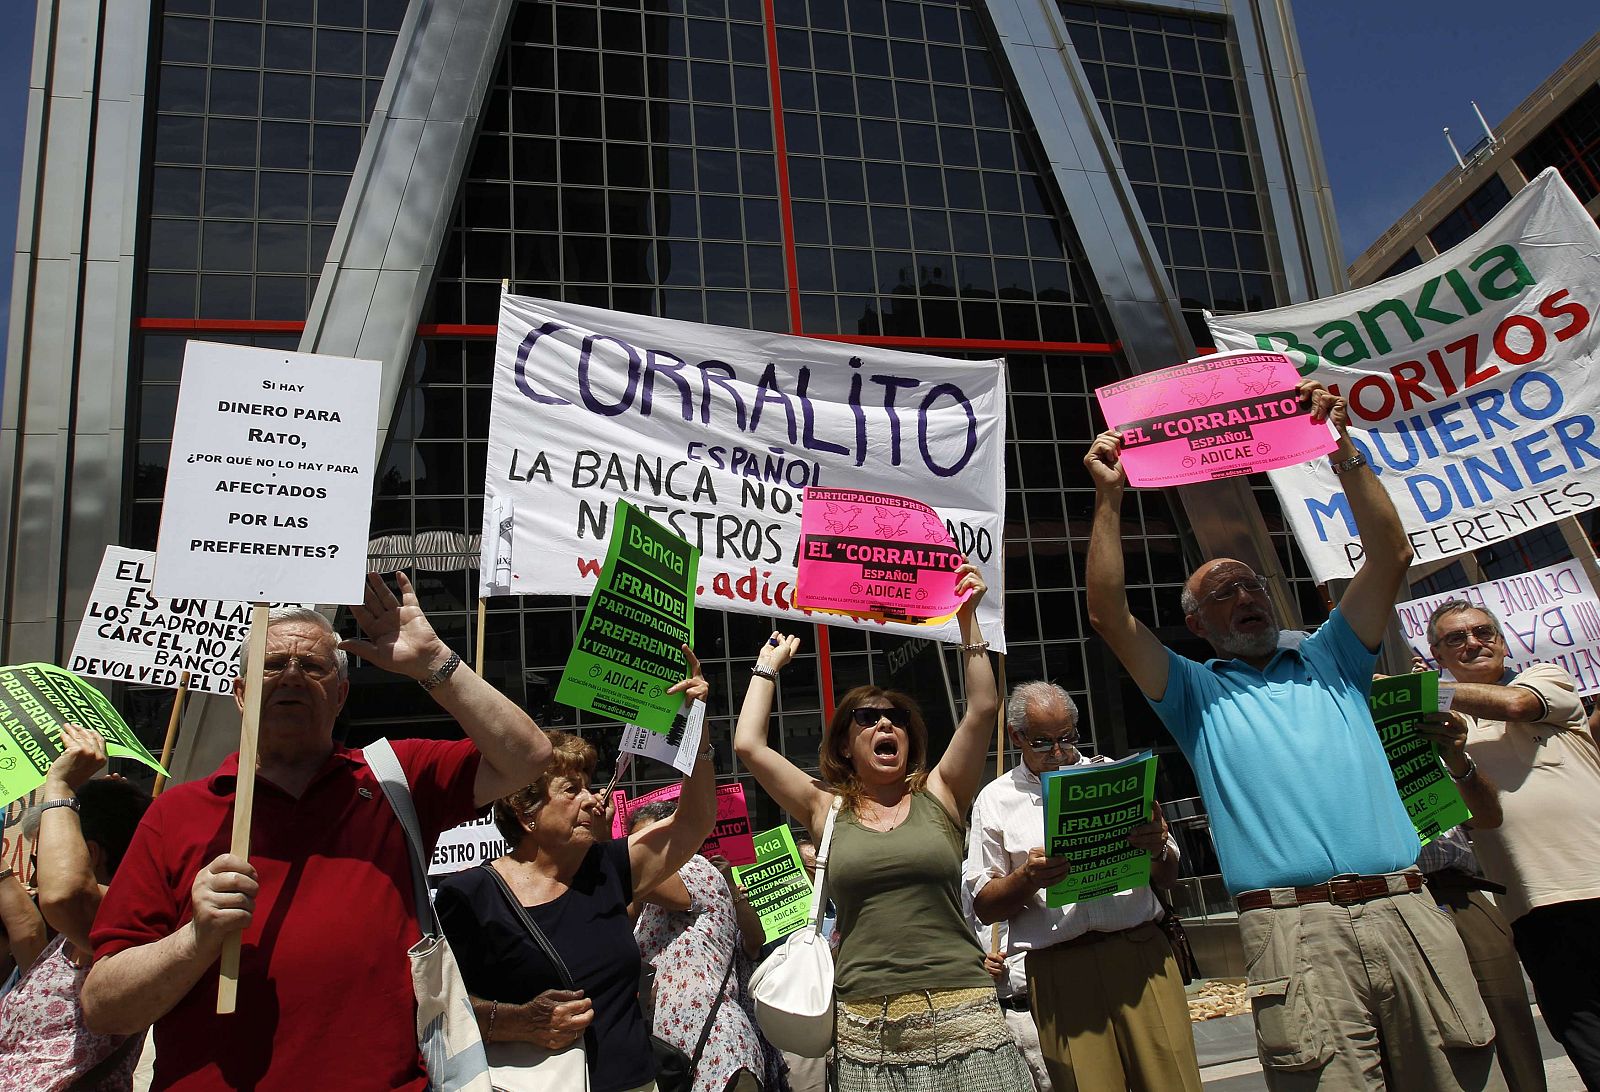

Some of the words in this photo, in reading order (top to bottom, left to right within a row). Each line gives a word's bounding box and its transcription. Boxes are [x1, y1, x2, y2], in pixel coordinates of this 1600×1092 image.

[1255, 244, 1537, 377] Bankia
[1328, 288, 1591, 428] ORIZOS
[279, 382, 305, 393] HAY
[1102, 364, 1206, 398] PARTICIPACIONES
[1206, 355, 1286, 371] PREFERENTES
[218, 400, 288, 418] DINERO
[293, 407, 342, 423] PARA
[248, 428, 307, 449] RATO,
[1122, 427, 1151, 446] EL
[1190, 430, 1251, 450] ESPAÑOL
[187, 453, 222, 464] ¿POR
[226, 455, 253, 467] QUÉ
[256, 458, 275, 468] NO
[278, 460, 294, 470] LO
[298, 462, 323, 472] HAY
[327, 464, 359, 475] PARA
[1200, 446, 1254, 466] ADICAE
[215, 480, 327, 499] AFECTADOS
[509, 448, 552, 482] LA
[572, 450, 717, 504] BANCA
[1304, 492, 1358, 543] M
[1404, 413, 1600, 525] DINER
[808, 491, 901, 507] PARTICIPACIONES
[228, 512, 267, 526] POR
[273, 515, 309, 529] LAS
[577, 499, 782, 564] NSTROS
[1344, 482, 1595, 572] PFERENTES
[190, 539, 340, 559] PREFERENTES?
[629, 524, 684, 577] Bankia
[808, 541, 833, 559] EL
[115, 560, 151, 584] EL
[863, 569, 916, 582] ESPAÑOL
[126, 587, 159, 611] ES
[169, 598, 207, 618] UN
[613, 571, 685, 620] ¡FRAUDE!
[865, 584, 912, 600] ADICAE
[89, 602, 132, 624] LOS
[140, 611, 249, 642] LADRONES
[597, 595, 689, 644] PARTICIPACIONES
[98, 623, 192, 654] CARCEL,
[196, 638, 226, 658] NO
[590, 616, 688, 667] PREFERENTES
[154, 651, 240, 679] BANCOS
[582, 637, 592, 650] Y
[592, 641, 631, 665] VENTA
[631, 654, 685, 683] ACCIONES
[73, 656, 177, 686] DEVOLVED
[189, 673, 212, 692] EL
[602, 670, 649, 695] ADICAE
[54, 673, 120, 745] ¡FRAUDE!
[5, 718, 53, 773] ACCIONES
[1068, 776, 1138, 801] Bankia
[1062, 804, 1141, 835] ¡FRAUDE!
[432, 842, 475, 865] ESTRO
[754, 838, 781, 857] nkia
[1070, 860, 1097, 874] ENTA
[1100, 848, 1145, 867] ACCIONES
[743, 858, 793, 889] ¡FRAUDE!
[748, 870, 802, 897] ARTICIPACIONES
[1081, 868, 1118, 885] ADICAE
[756, 902, 780, 917] VENTA
[780, 888, 811, 907] ACCIONES
[773, 905, 799, 922] ADICAE
